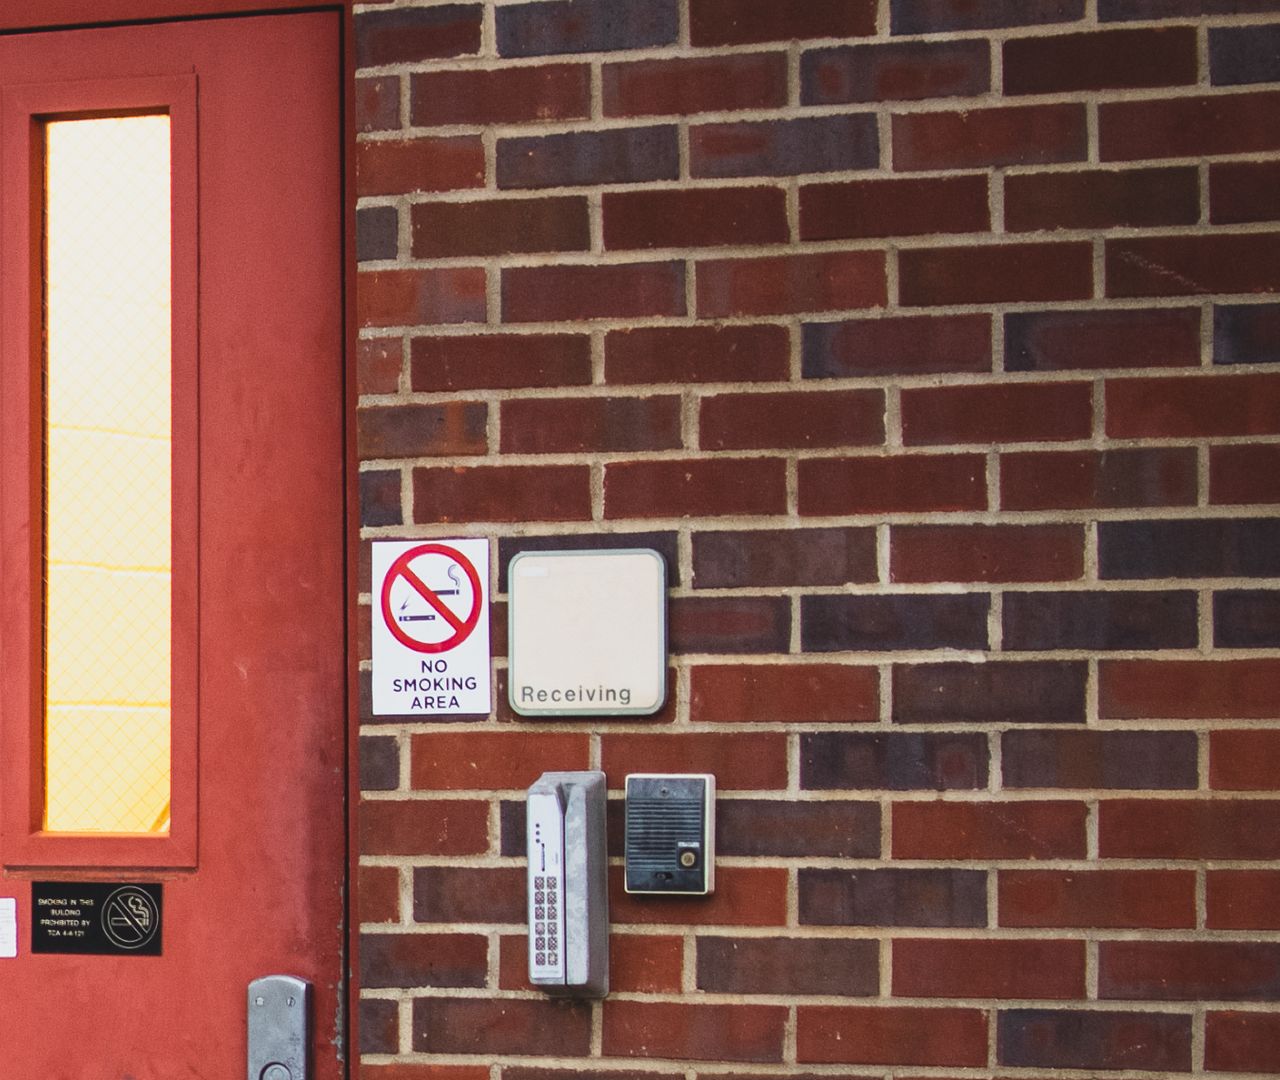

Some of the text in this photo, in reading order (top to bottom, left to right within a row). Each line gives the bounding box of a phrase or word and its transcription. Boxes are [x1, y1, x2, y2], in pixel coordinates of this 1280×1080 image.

[421, 659, 448, 673] NO
[393, 676, 478, 693] SMOKING
[521, 685, 632, 705] Receiving
[410, 695, 460, 710] AREA
[38, 898, 68, 906] SMOKING
[40, 919, 91, 927] PROHIBITED BY
